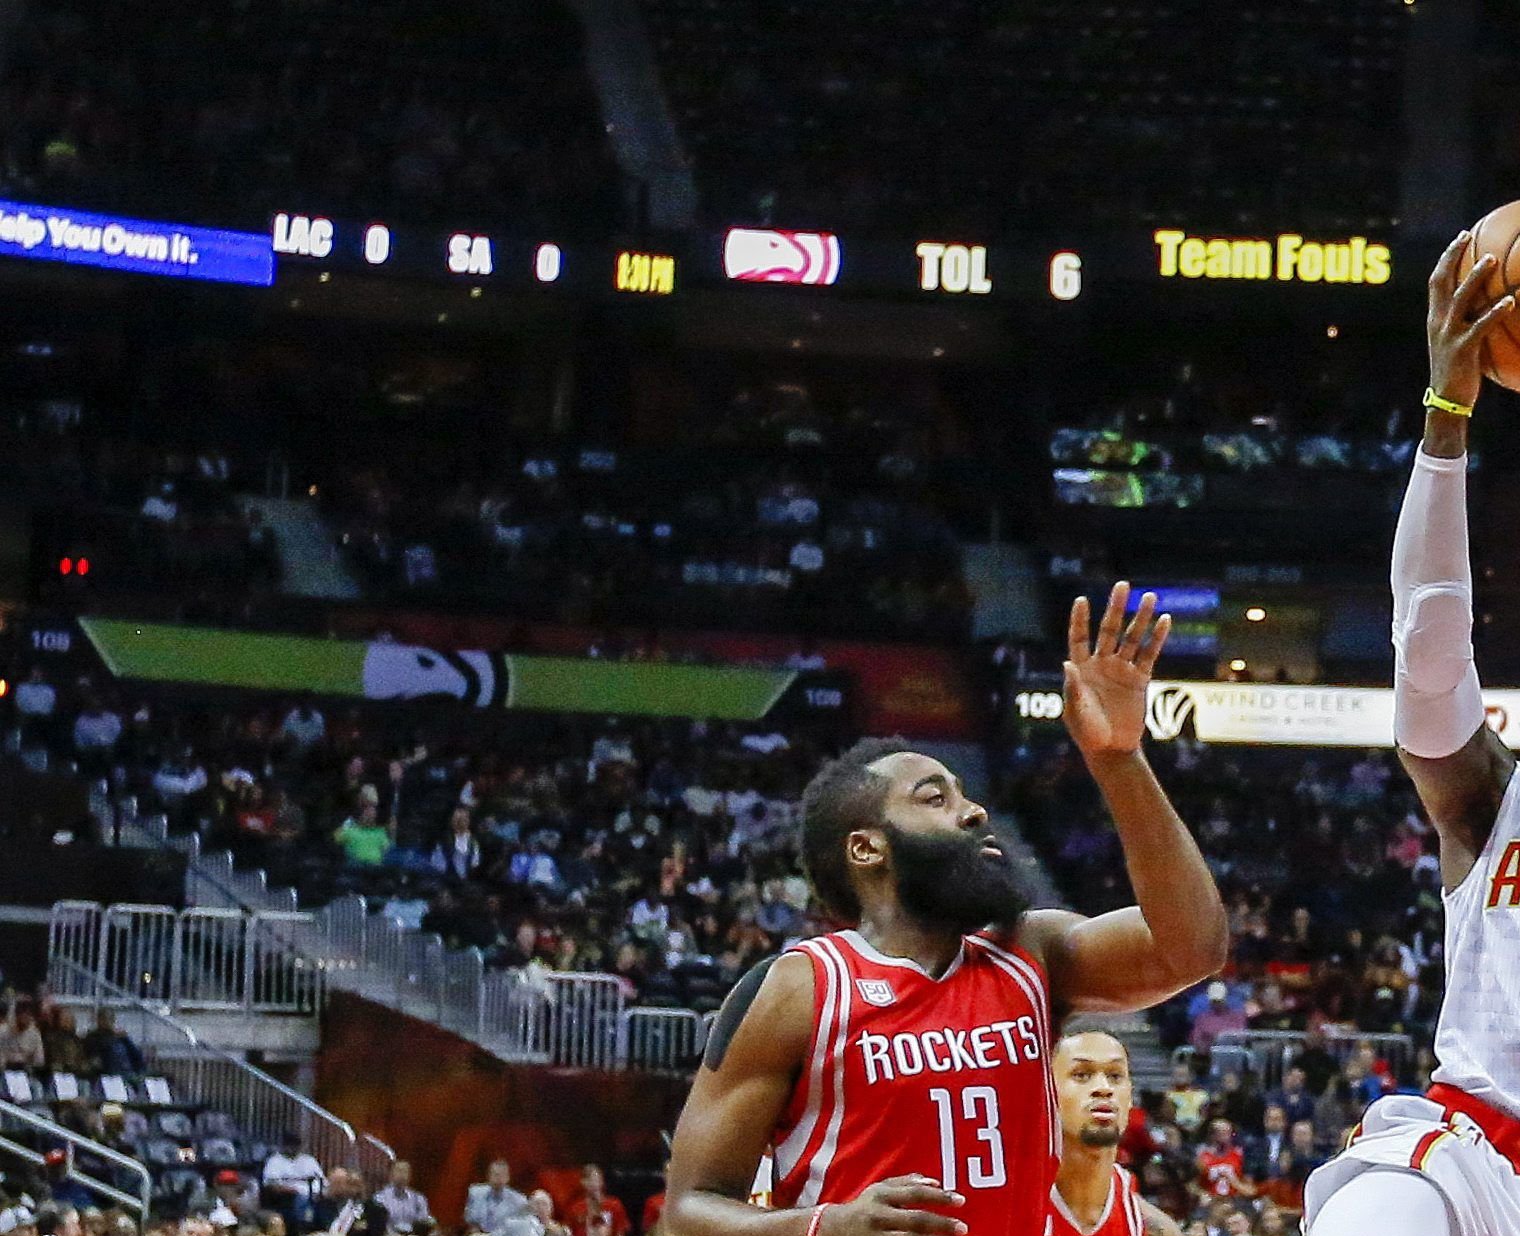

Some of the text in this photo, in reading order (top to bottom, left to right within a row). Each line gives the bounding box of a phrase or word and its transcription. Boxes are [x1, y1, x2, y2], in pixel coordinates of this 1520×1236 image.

[47, 216, 101, 252] You
[102, 224, 169, 263] Own
[273, 213, 561, 282] LAC 0 SA 0
[1155, 230, 1391, 285] Team Fouls
[917, 243, 1082, 300] TOL 6
[1015, 691, 1063, 719] 109
[856, 1015, 1042, 1085] ROCKETS
[929, 1086, 1006, 1191] 13
